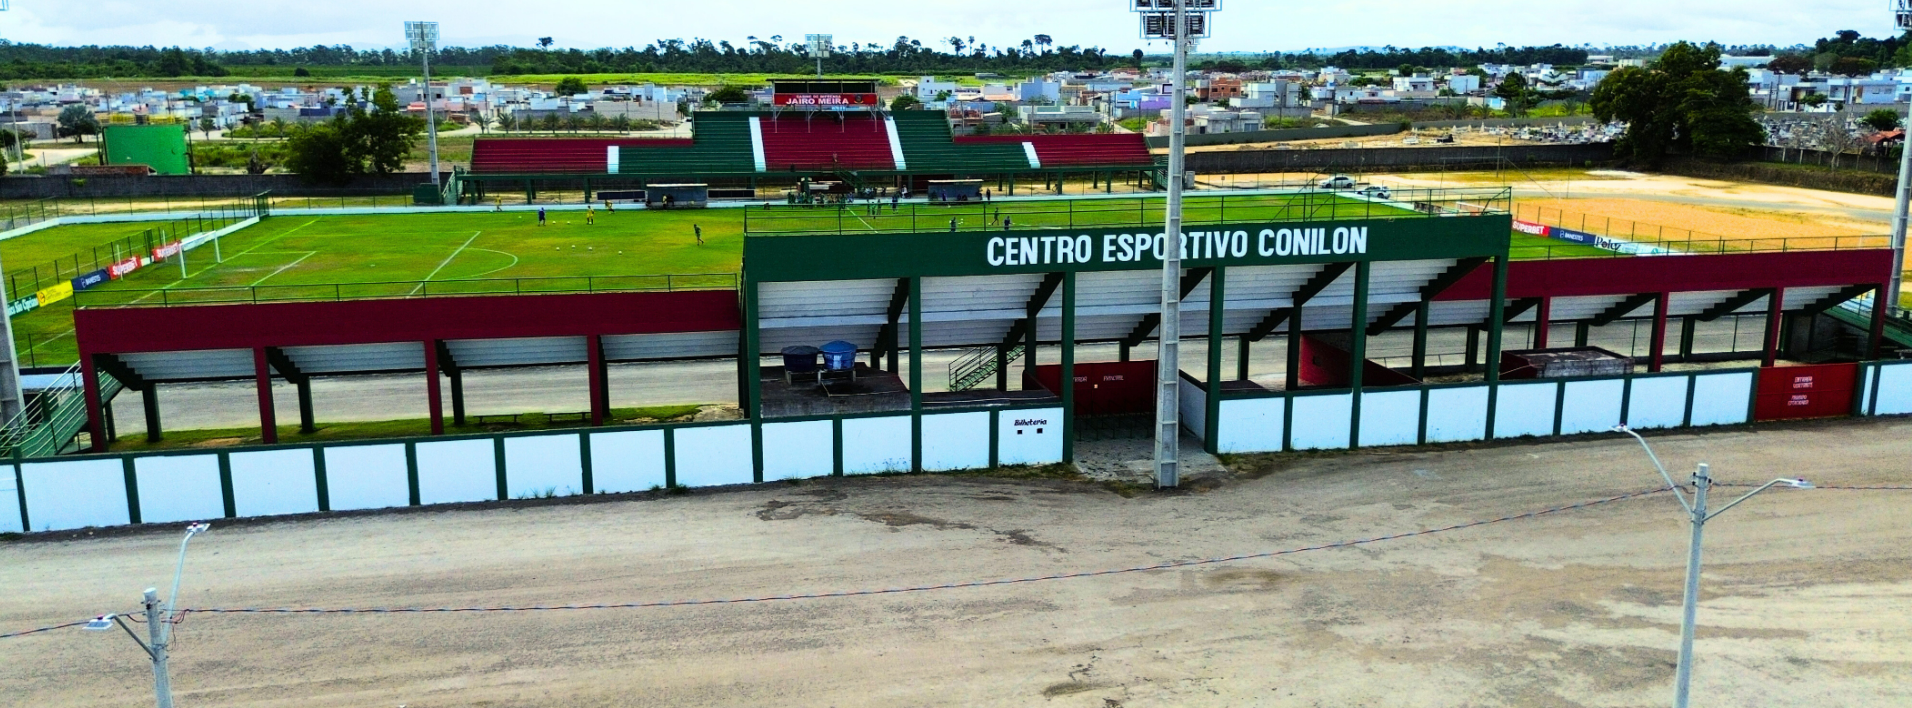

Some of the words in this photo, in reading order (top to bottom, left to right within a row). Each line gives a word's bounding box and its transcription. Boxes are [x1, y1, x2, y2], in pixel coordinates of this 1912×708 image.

[1511, 221, 1544, 236] SUPERBET
[986, 235, 1092, 266] CENTRO
[1258, 226, 1368, 257] CONILON
